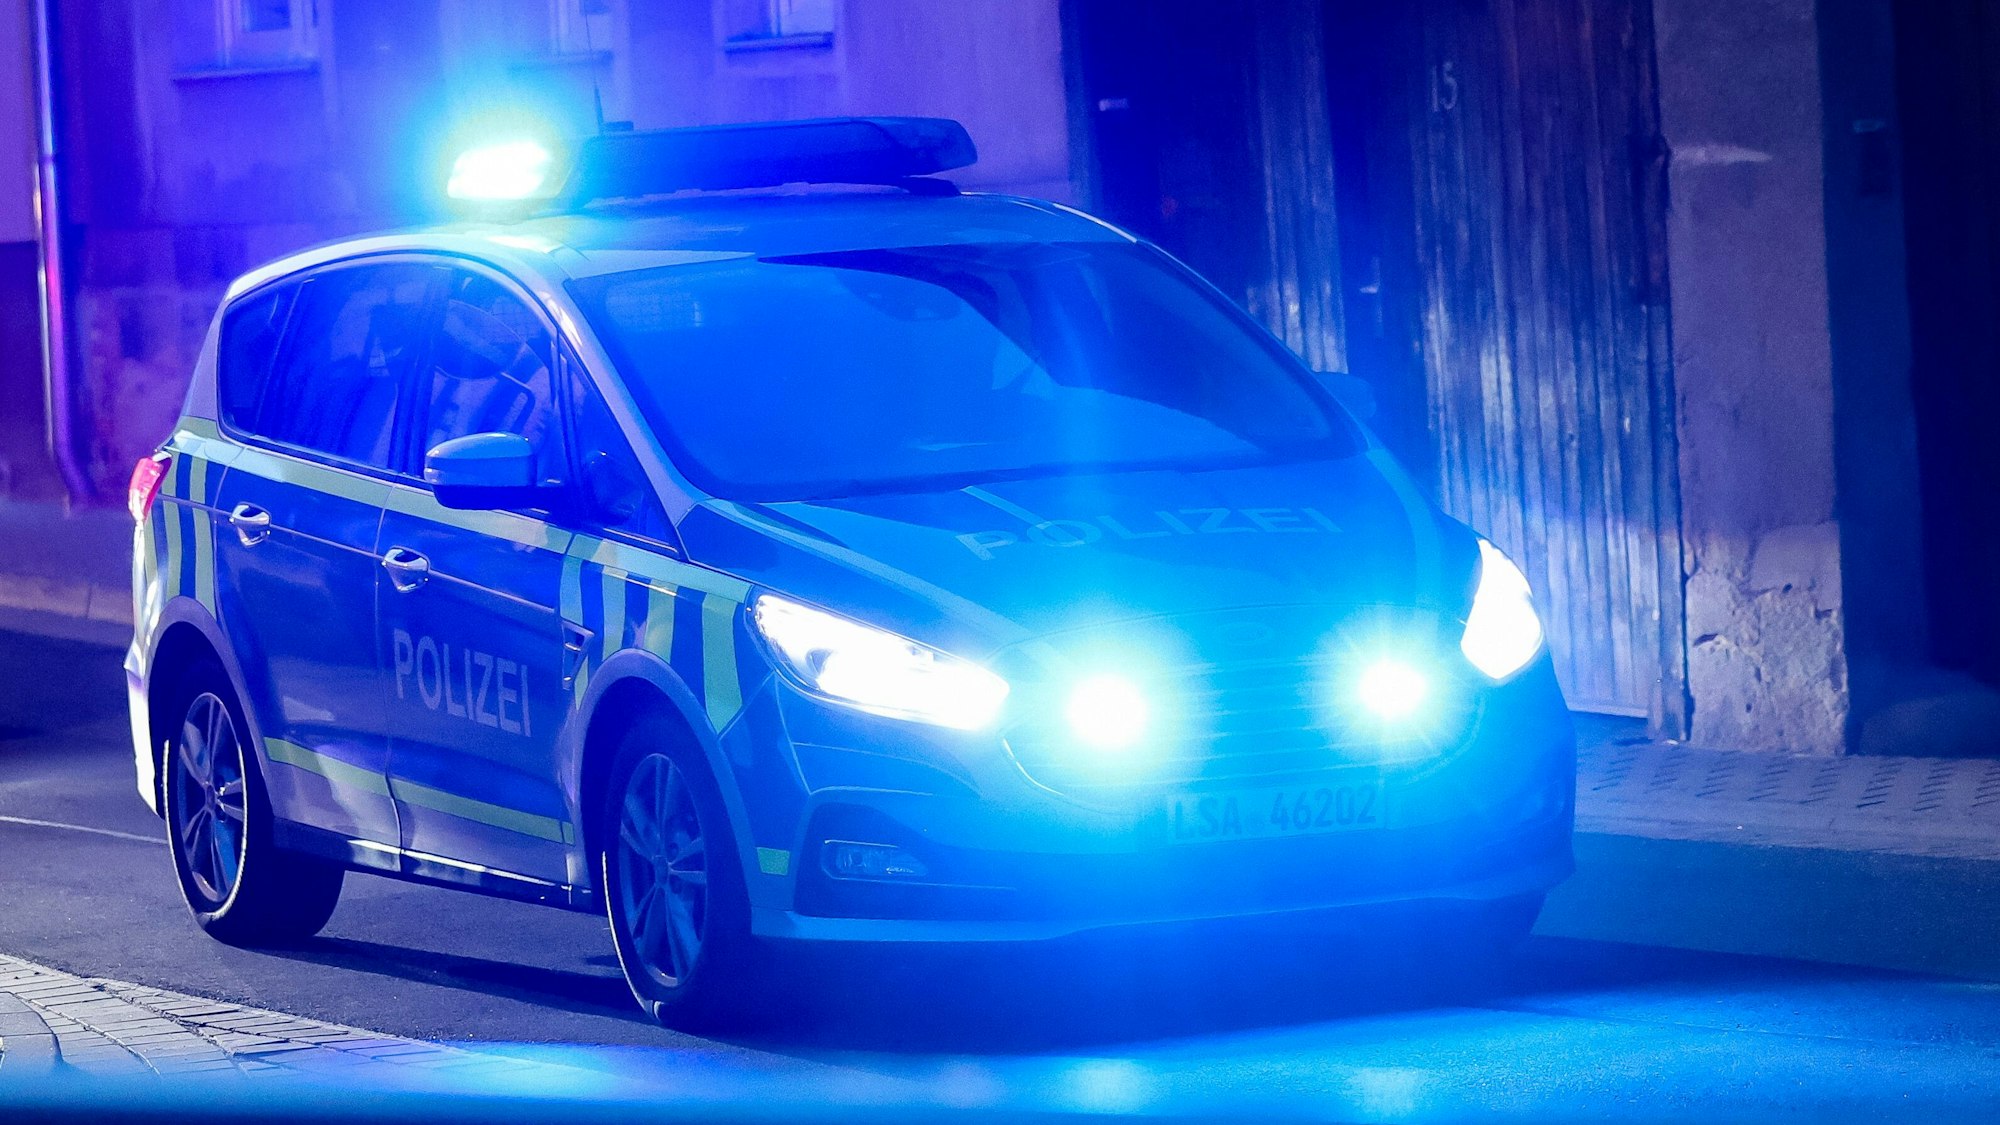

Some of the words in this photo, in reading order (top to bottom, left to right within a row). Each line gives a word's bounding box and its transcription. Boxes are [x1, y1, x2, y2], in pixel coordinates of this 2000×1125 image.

[1430, 62, 1458, 112] 15
[955, 507, 1344, 561] POLIZEI
[393, 627, 532, 738] POLIZEI
[1174, 796, 1243, 841] LSA
[1270, 784, 1377, 832] 46202
